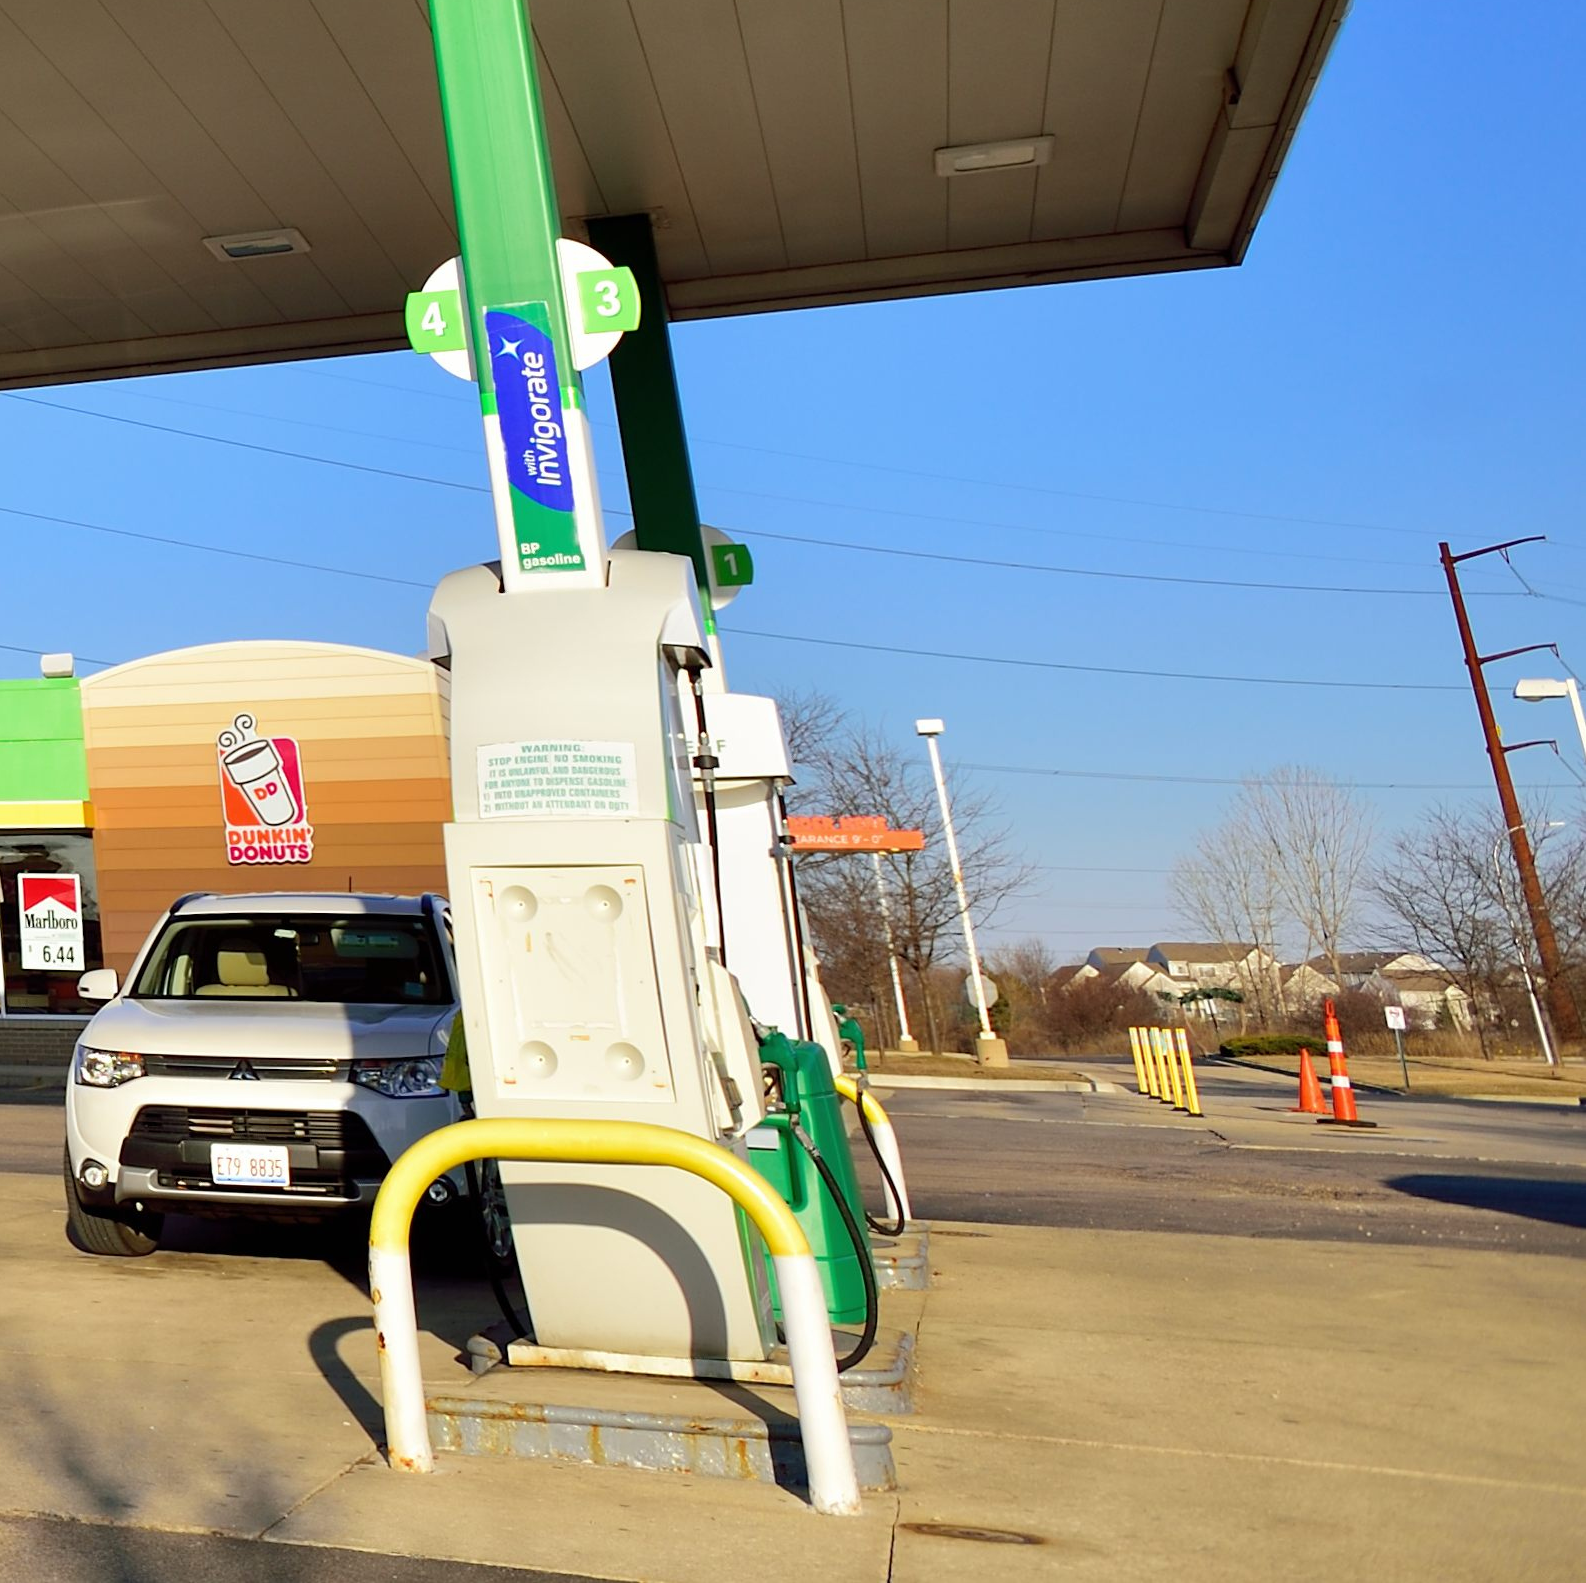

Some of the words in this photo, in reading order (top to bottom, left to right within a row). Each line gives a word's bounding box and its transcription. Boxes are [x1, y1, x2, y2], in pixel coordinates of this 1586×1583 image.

[594, 280, 621, 317] 3
[421, 301, 447, 337] 4
[521, 351, 562, 487] Invigorate
[522, 449, 538, 476] with
[520, 542, 540, 555] BP
[523, 552, 581, 569] gasoline
[723, 552, 738, 576] 1
[488, 757, 512, 767] STOP
[515, 755, 549, 764] ENGINE
[554, 754, 569, 763] NO
[572, 754, 622, 764] SMOKING
[508, 767, 550, 777] UNLAWFUL
[553, 766, 569, 775] AND
[572, 766, 621, 776] DANGEROUS
[254, 782, 278, 800] DD
[501, 779, 530, 788] ANYONE
[533, 778, 543, 786] TO
[545, 777, 584, 786] DISPENSE
[514, 788, 567, 798] UNAPPROVED
[569, 788, 621, 798] CONTAINERS
[495, 801, 529, 811] WITHOUT
[545, 799, 591, 809] ATTENDANT
[228, 827, 312, 845] DUNKIN'
[794, 834, 848, 844] EARANCE
[229, 844, 310, 861] DONUTS
[24, 909, 78, 930] Marlboro
[42, 945, 75, 964] 6.44
[217, 1157, 241, 1176] E79
[250, 1158, 283, 1178] 8835
